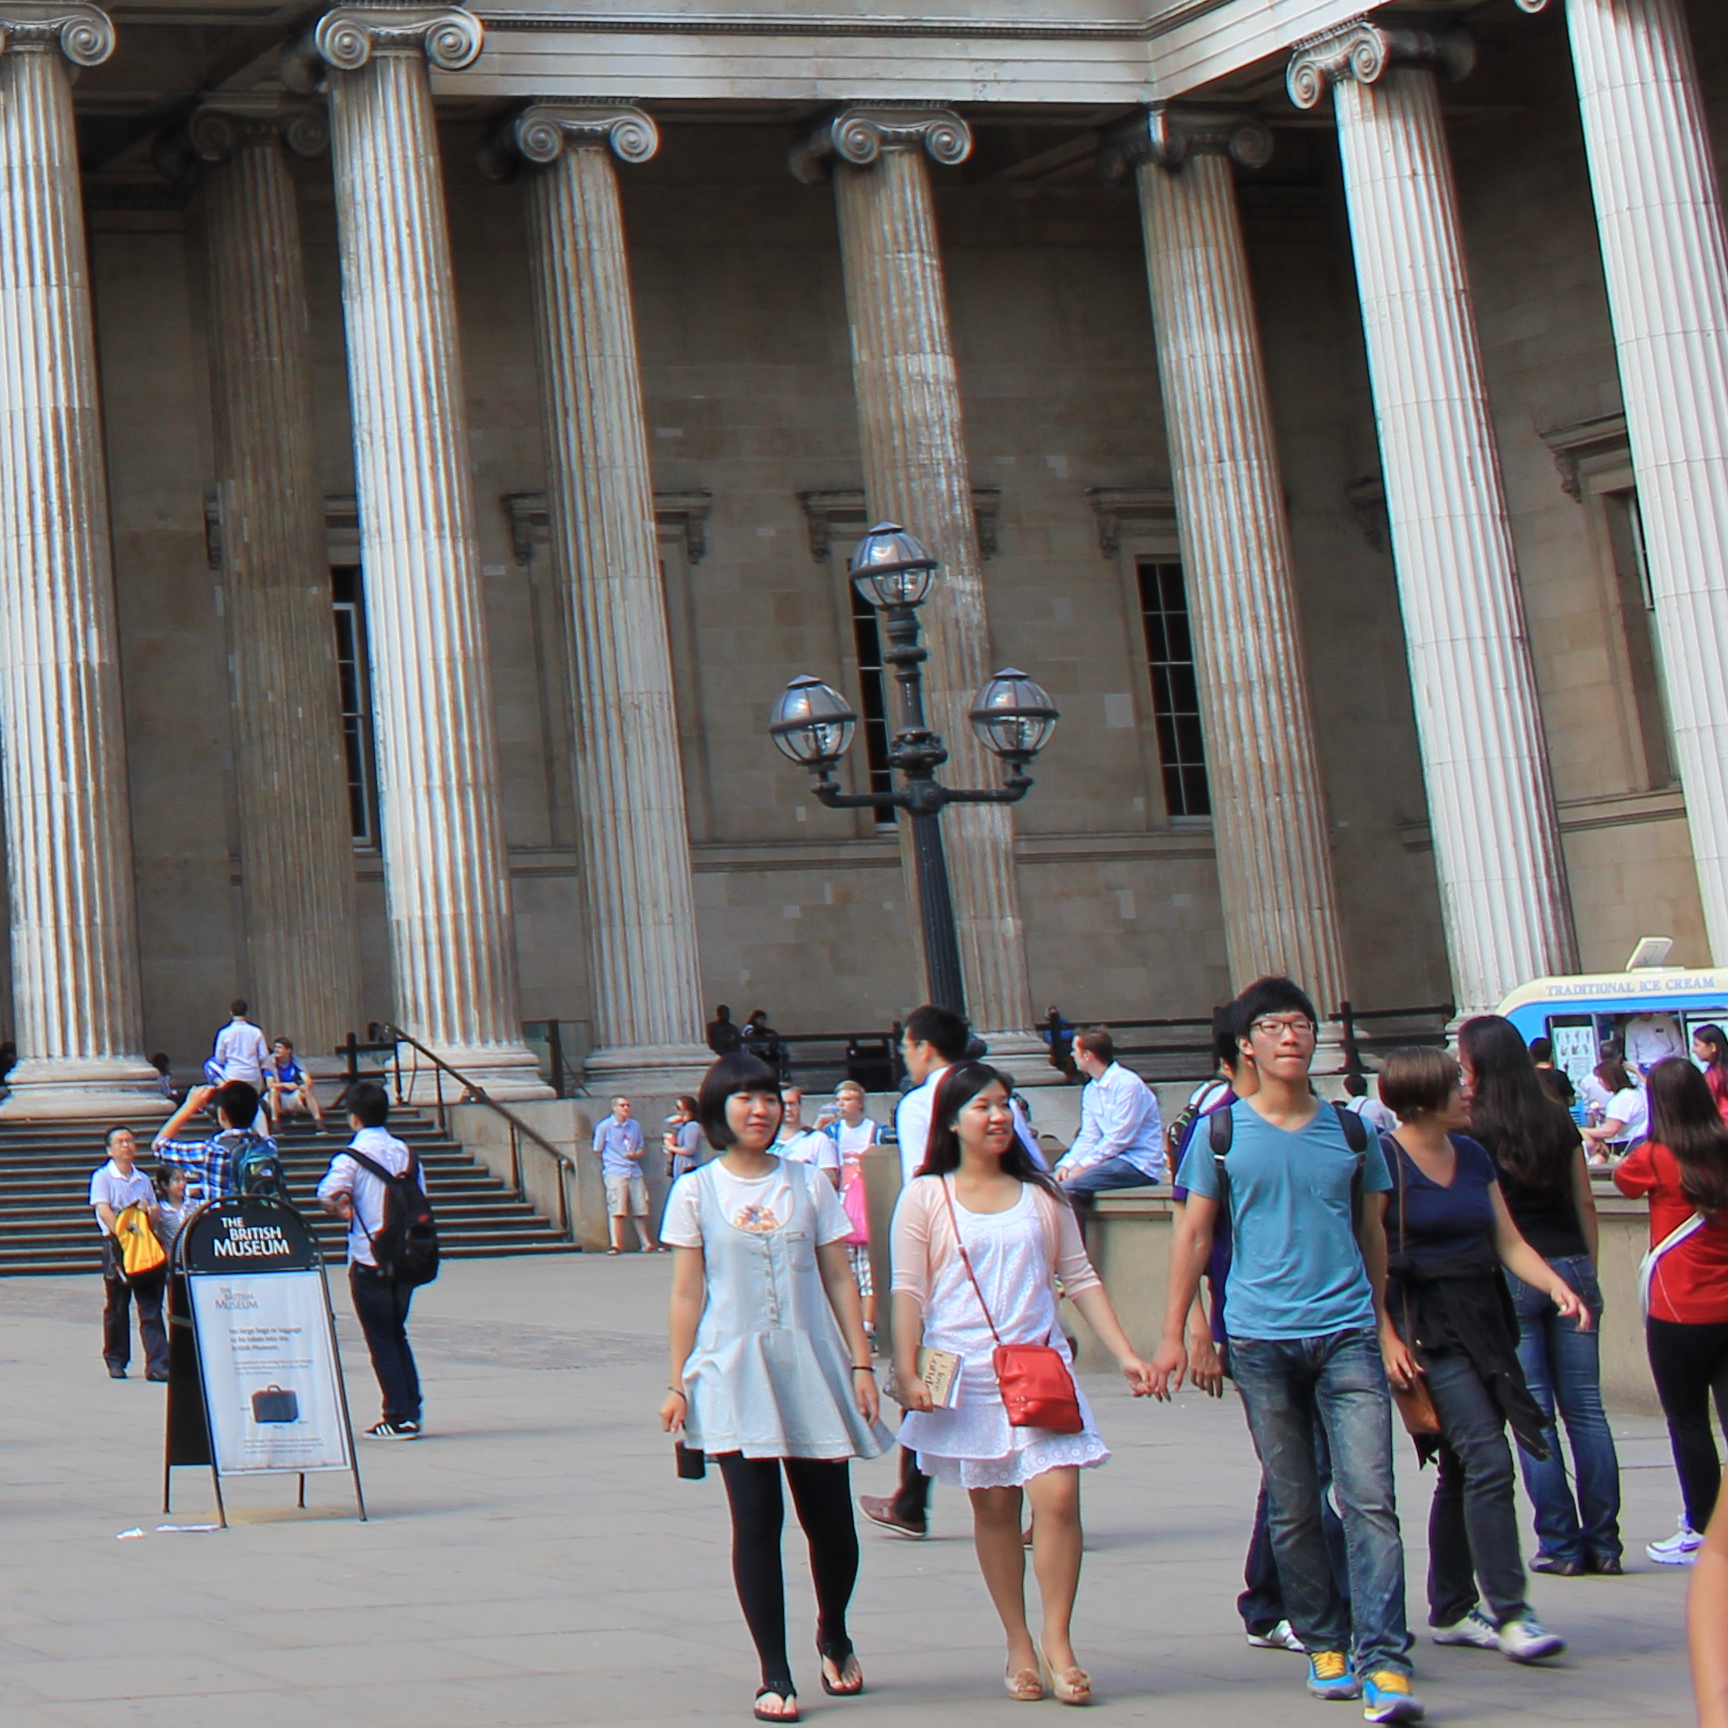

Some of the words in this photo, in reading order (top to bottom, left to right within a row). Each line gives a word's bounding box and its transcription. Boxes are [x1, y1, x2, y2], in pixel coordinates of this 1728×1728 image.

[1546, 982, 1634, 996] TRADITIONAL
[1639, 980, 1661, 992] ICE
[1665, 977, 1715, 991] CREAM
[220, 1216, 245, 1228] THE
[229, 1225, 282, 1241] BRITISH
[213, 1238, 290, 1257] MUSEUM
